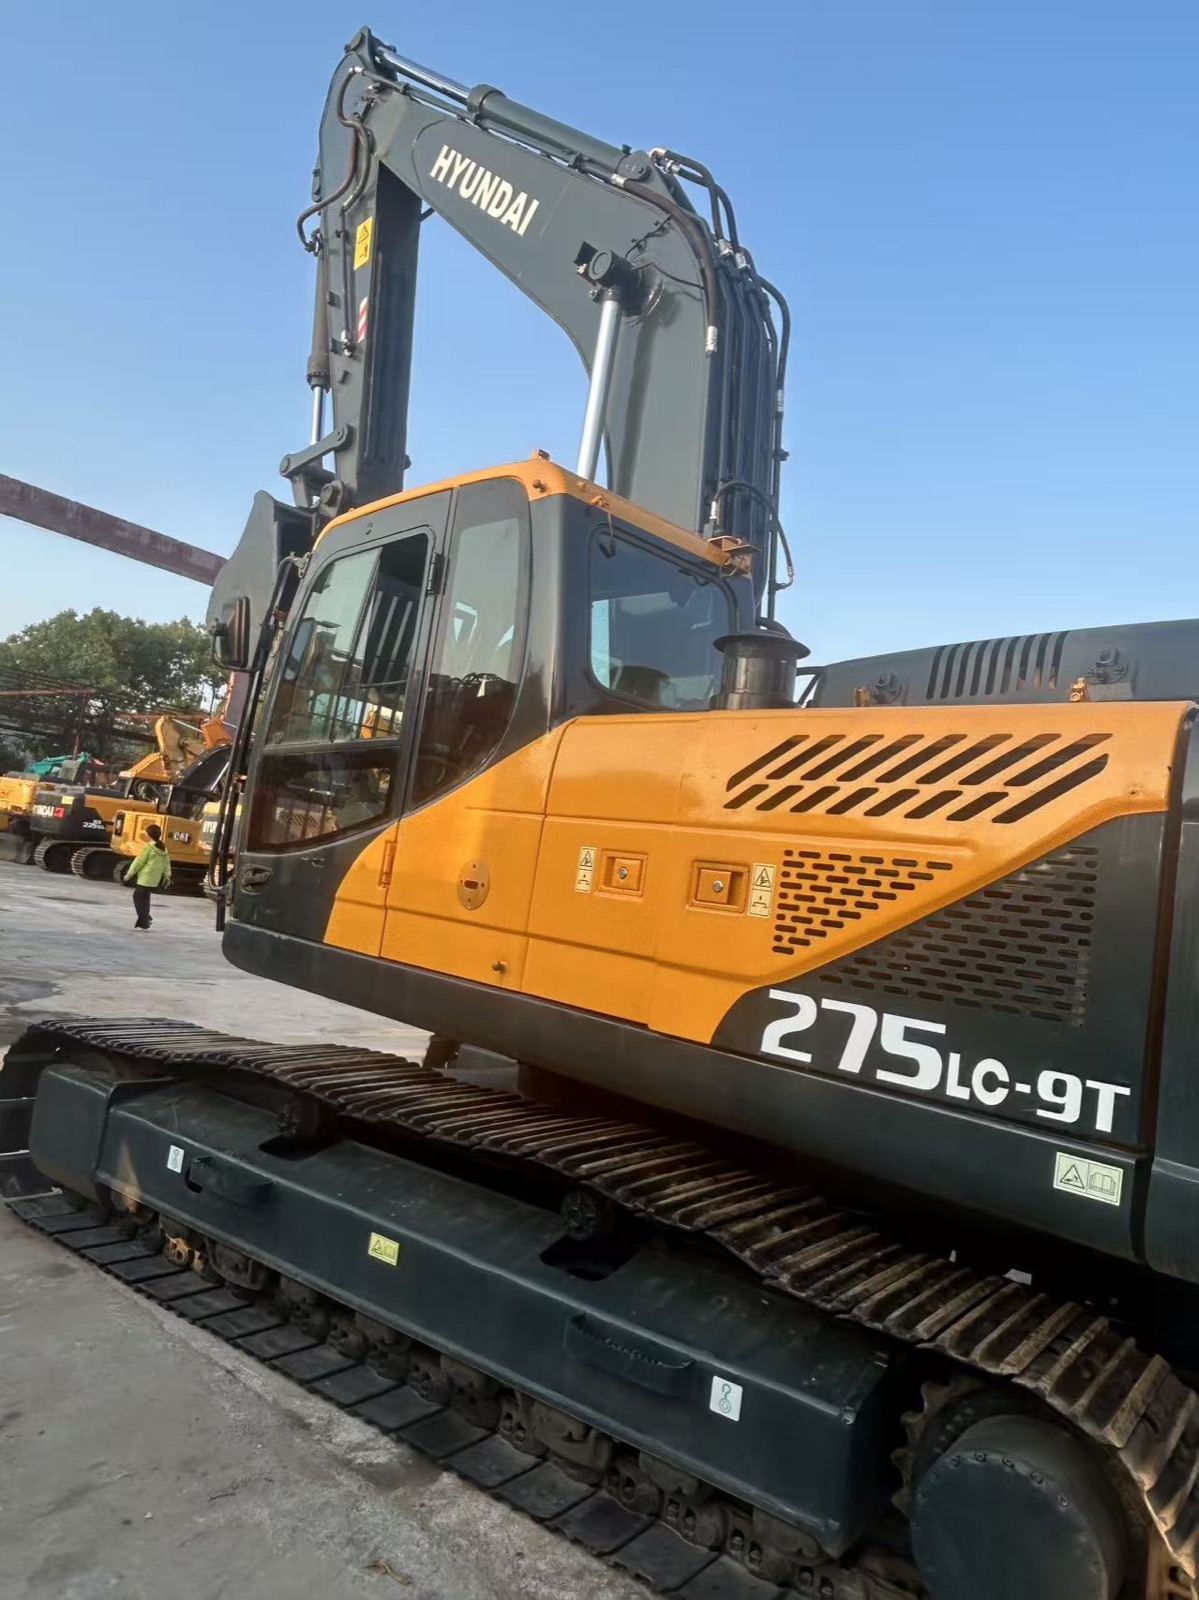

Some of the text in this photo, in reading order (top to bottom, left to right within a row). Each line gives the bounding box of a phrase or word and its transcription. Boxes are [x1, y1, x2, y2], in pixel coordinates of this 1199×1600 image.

[429, 144, 540, 237] HYUNDAI
[173, 831, 189, 843] CAT
[759, 988, 1132, 1134] 275LC-9T
